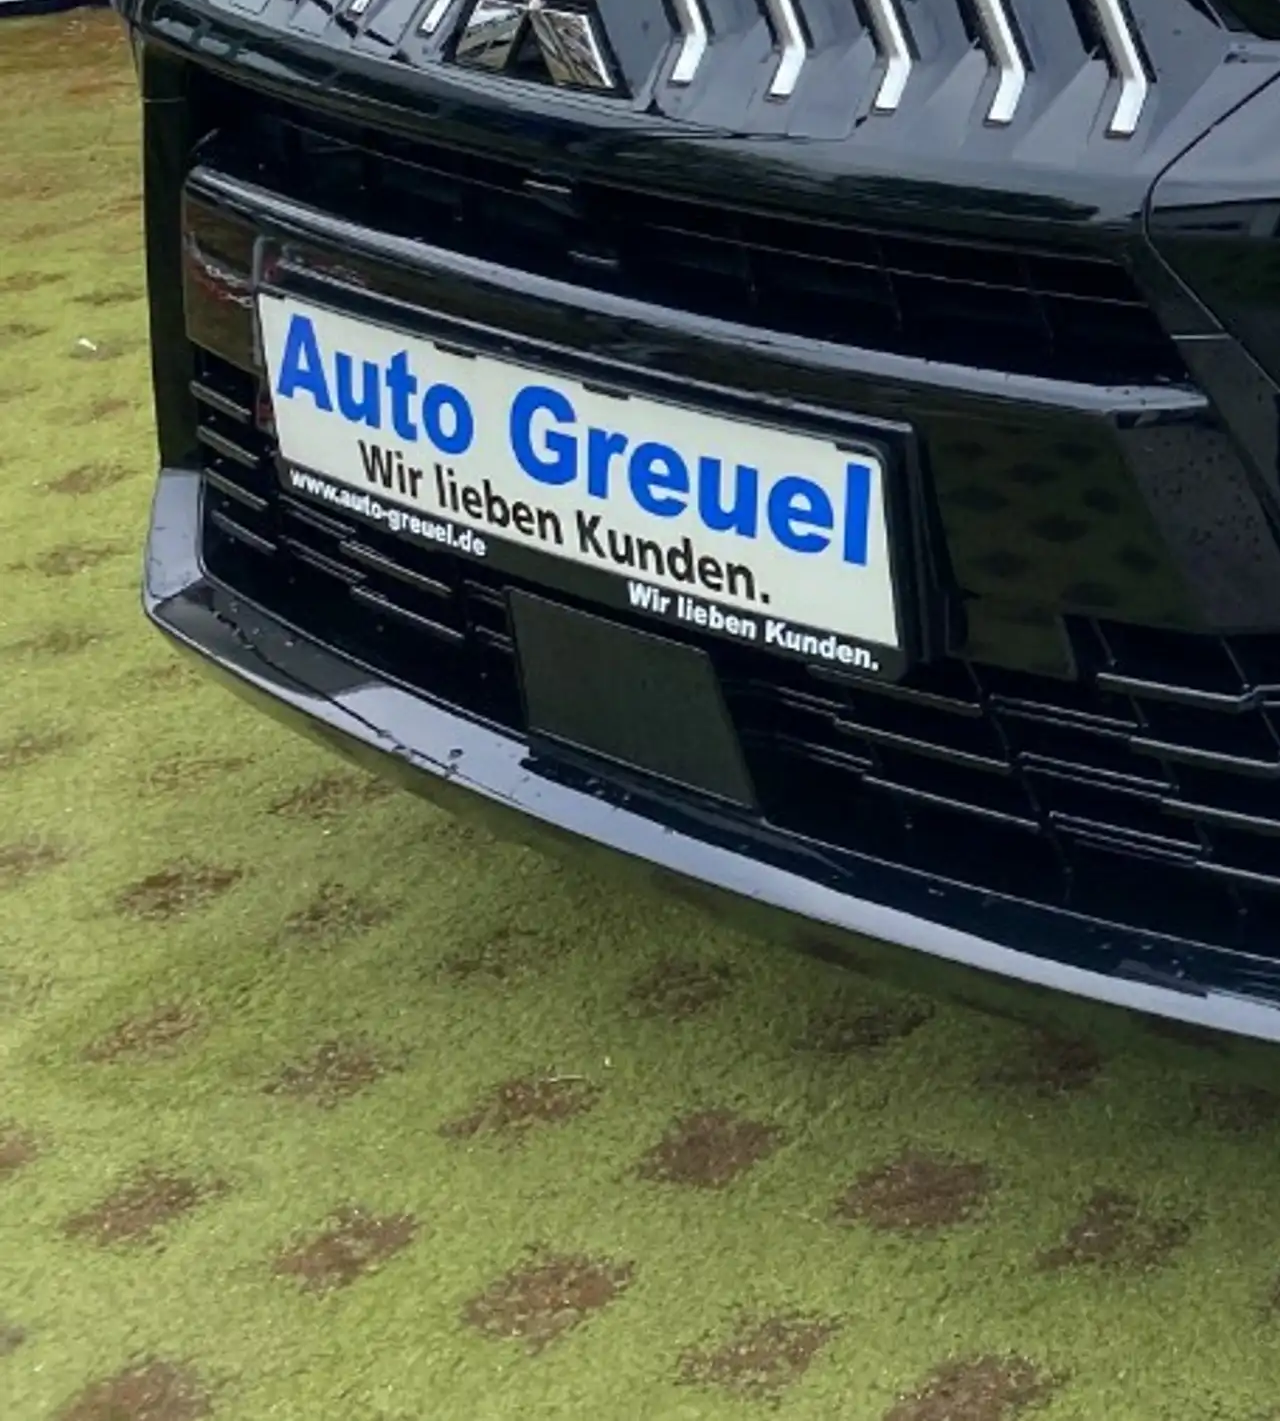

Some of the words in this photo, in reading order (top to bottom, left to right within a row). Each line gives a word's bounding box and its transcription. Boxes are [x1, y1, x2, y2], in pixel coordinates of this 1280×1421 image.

[276, 313, 475, 456] Auto
[509, 385, 871, 566] Greuel
[289, 467, 487, 556] www.auto-greuel.de
[358, 440, 422, 498] Wir
[434, 463, 563, 545] lieben
[576, 509, 771, 604] Kunden.
[628, 581, 671, 614] Wir
[678, 595, 757, 640] lieben
[765, 619, 880, 671] Kunden.
